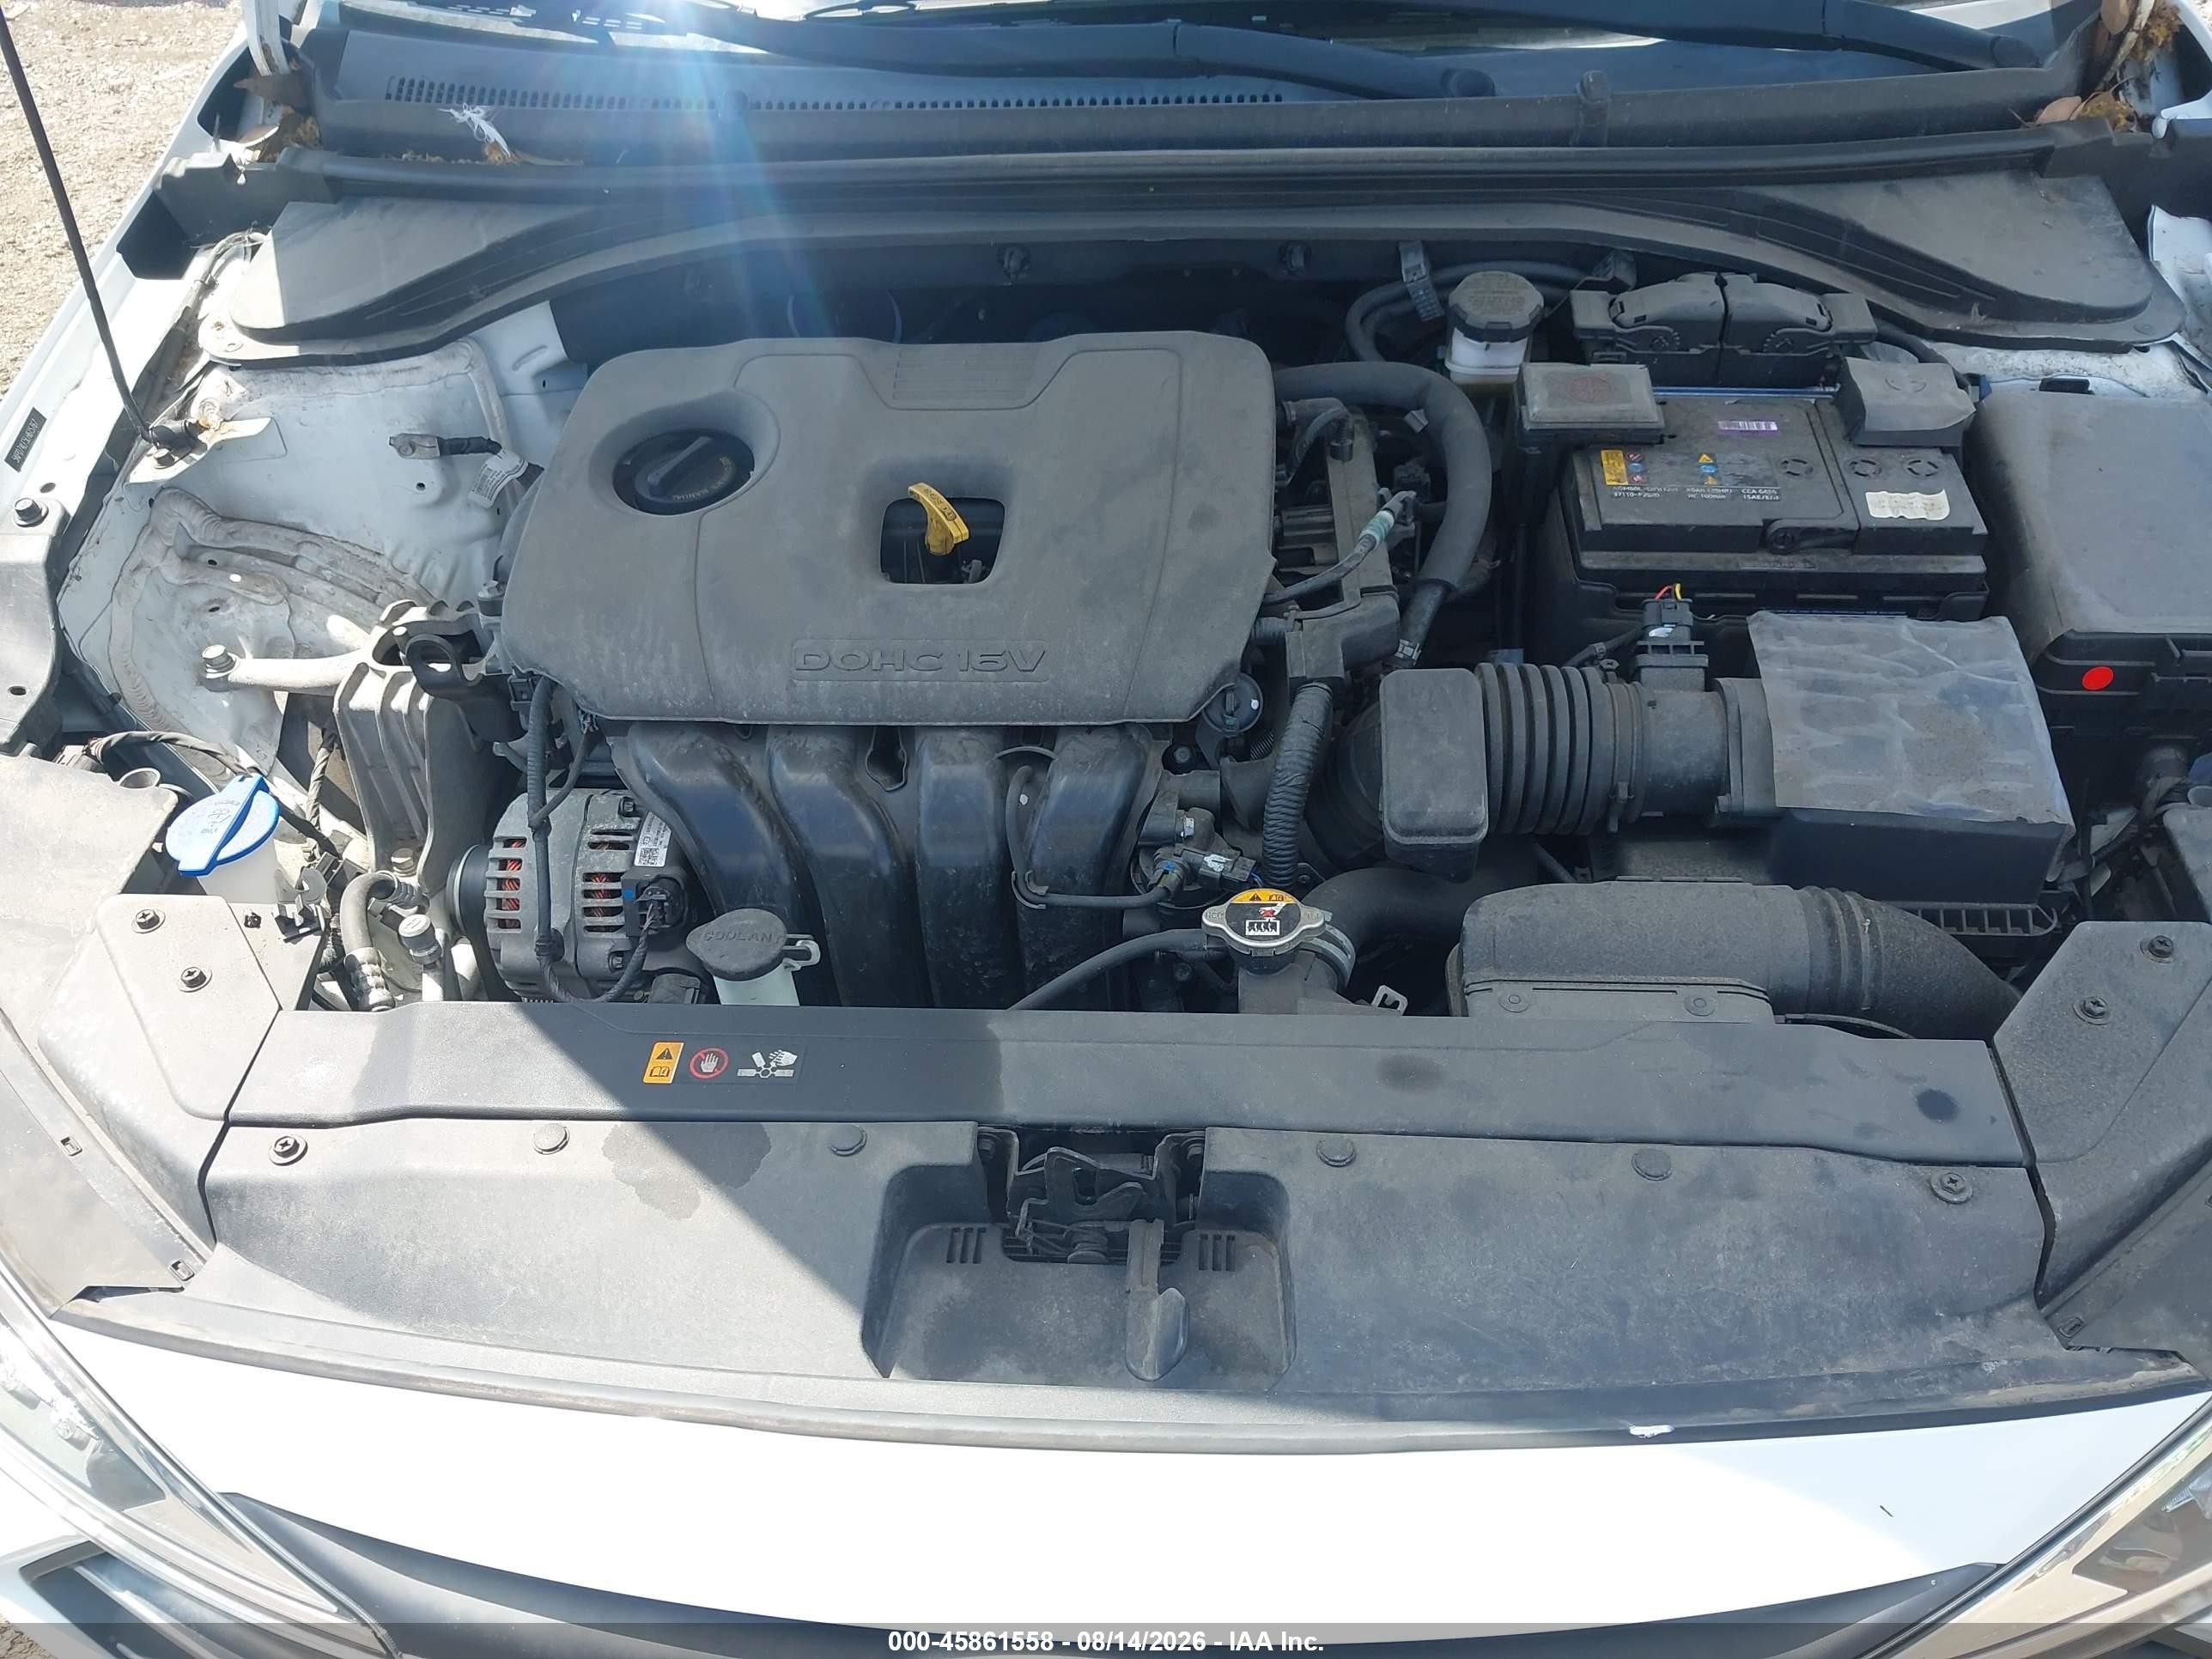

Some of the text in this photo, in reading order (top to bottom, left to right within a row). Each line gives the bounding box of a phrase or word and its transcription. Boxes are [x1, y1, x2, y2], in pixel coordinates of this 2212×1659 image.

[794, 649, 1047, 673] DOHC 16V
[702, 930, 785, 945] COOLANT
